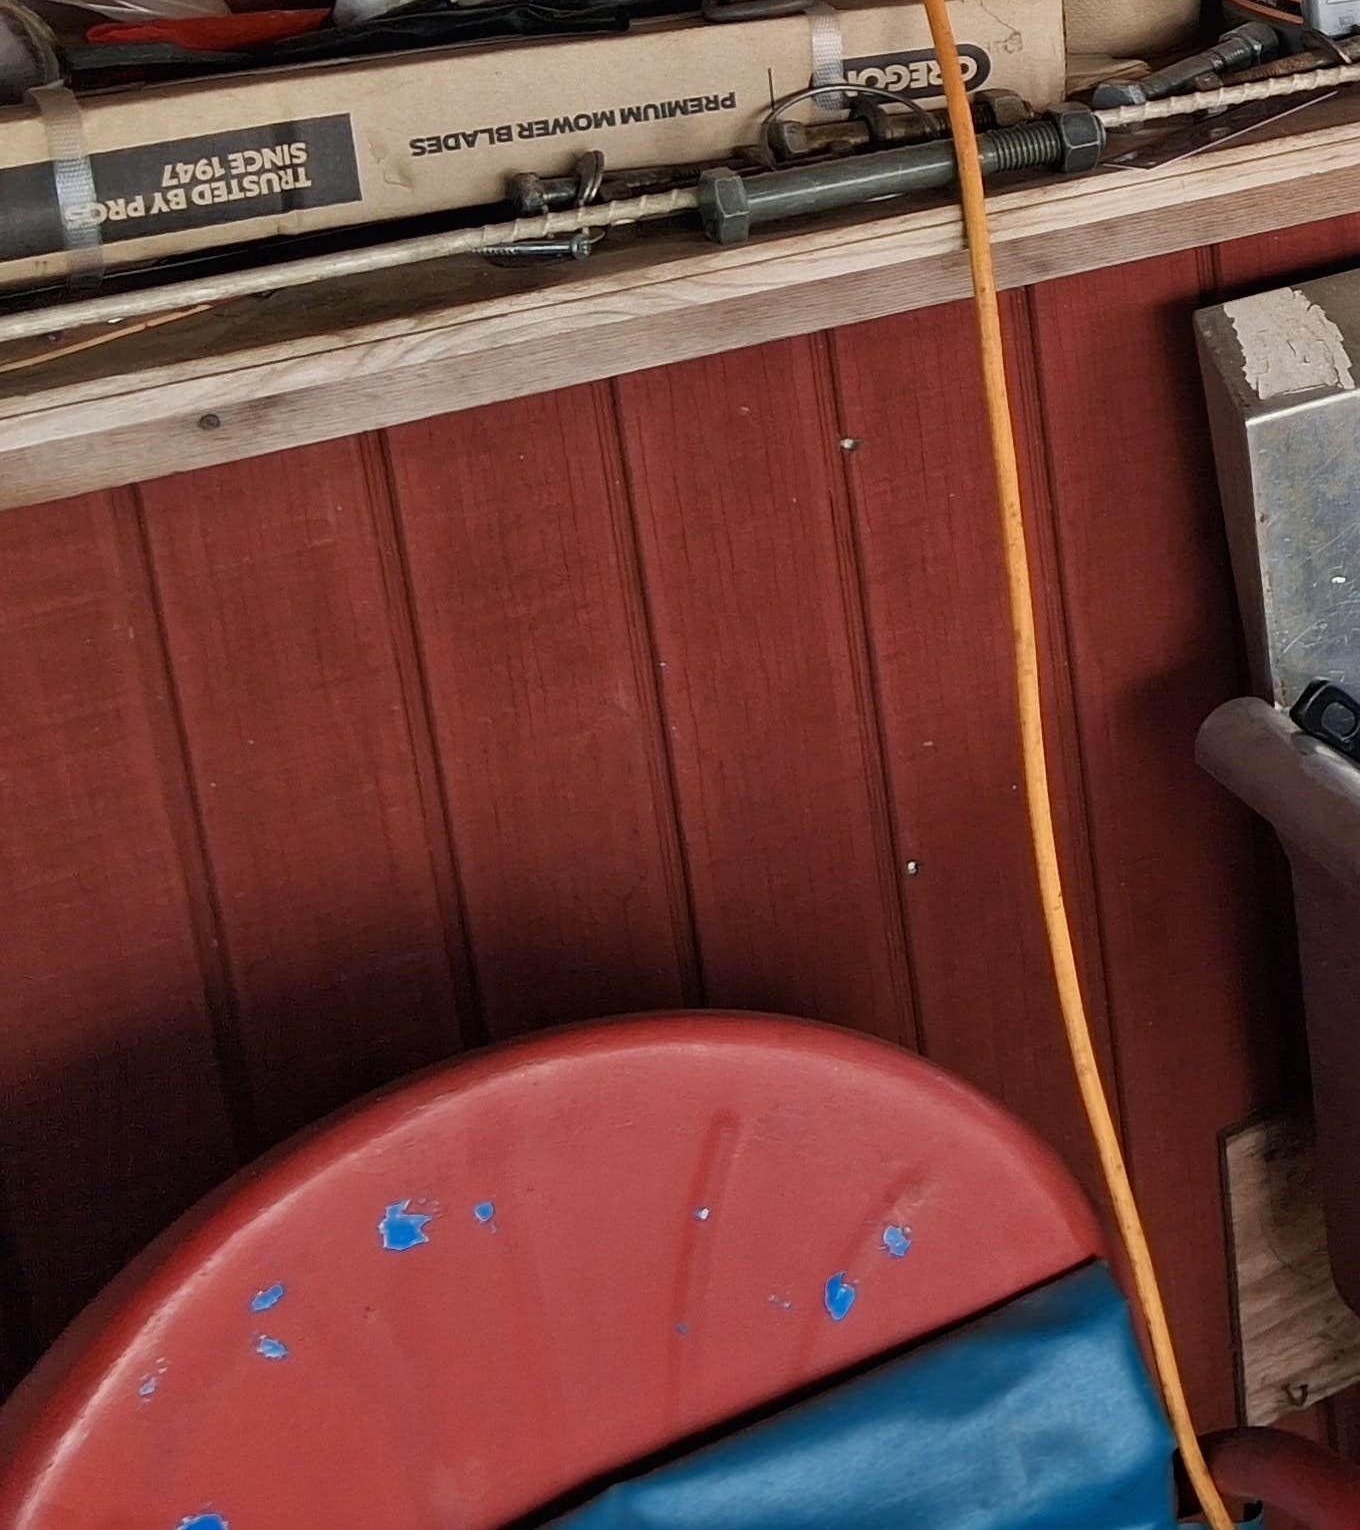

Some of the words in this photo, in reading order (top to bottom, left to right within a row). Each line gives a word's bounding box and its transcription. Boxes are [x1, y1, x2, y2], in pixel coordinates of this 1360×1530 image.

[514, 108, 617, 144] MOWER
[619, 90, 737, 130] PREMIUM
[226, 141, 309, 174] SINCE
[408, 124, 513, 158] BLADES
[160, 156, 225, 188] 1947
[191, 166, 313, 206] TRUSTED
[148, 187, 188, 215] BY
